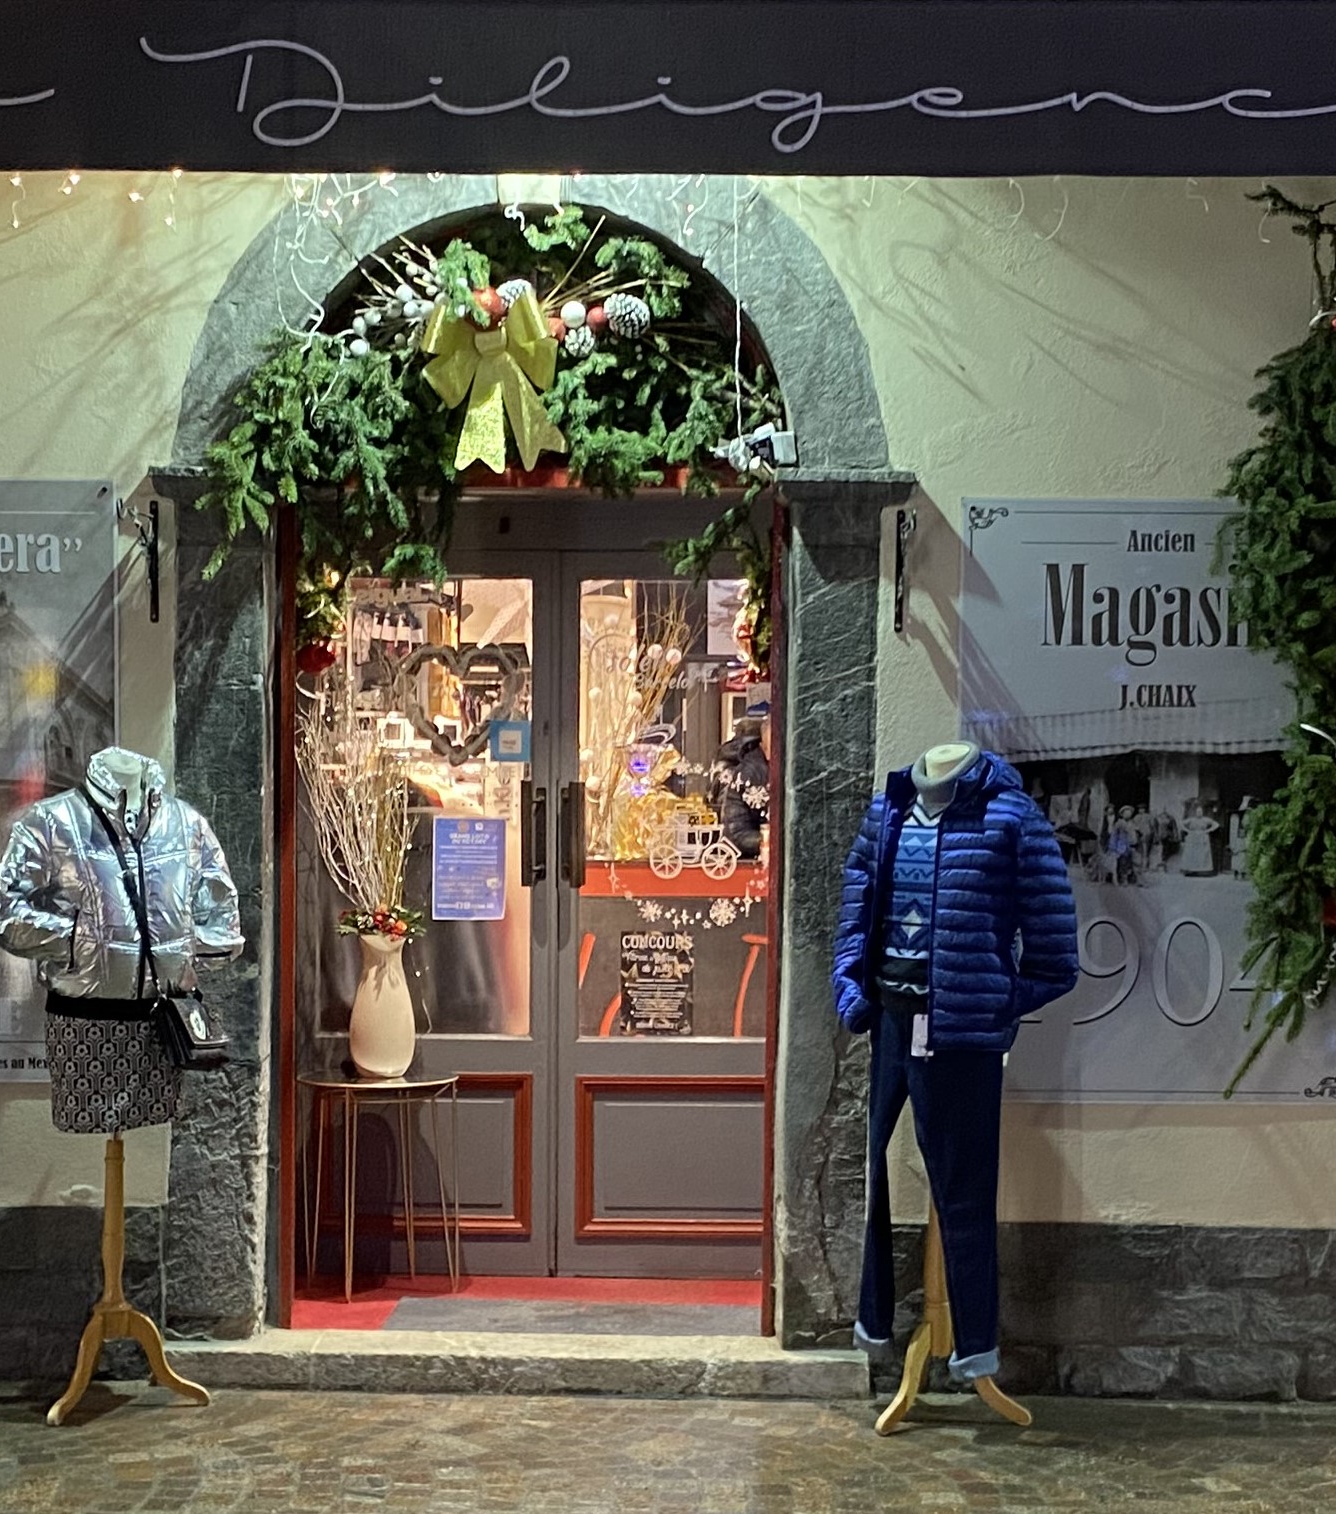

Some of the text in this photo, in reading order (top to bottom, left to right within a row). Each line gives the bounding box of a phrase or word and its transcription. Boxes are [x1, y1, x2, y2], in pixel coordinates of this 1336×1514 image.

[1126, 529, 1196, 552] Ancien
[1041, 562, 1255, 667] Magasi
[1119, 683, 1197, 711] J.CHAIX
[622, 934, 694, 950] CONCOURS
[10, 1058, 25, 1069] au
